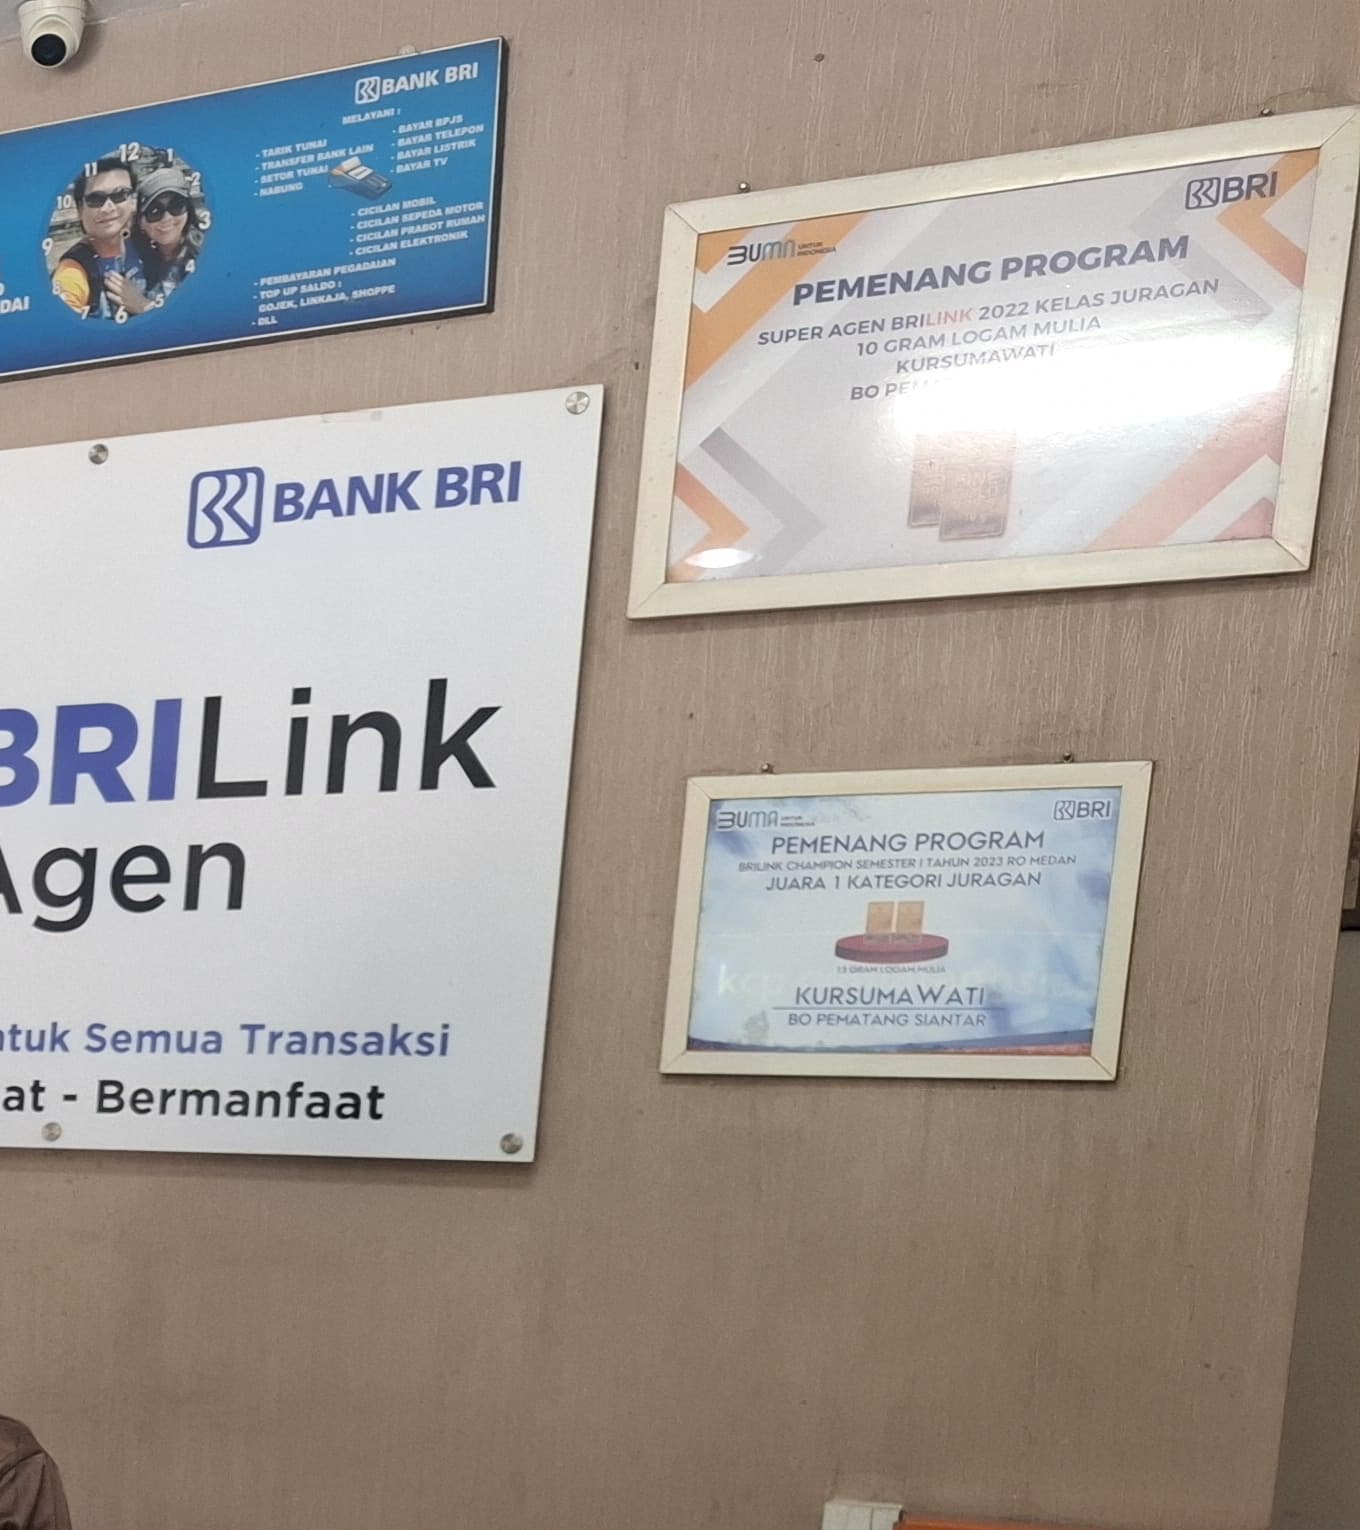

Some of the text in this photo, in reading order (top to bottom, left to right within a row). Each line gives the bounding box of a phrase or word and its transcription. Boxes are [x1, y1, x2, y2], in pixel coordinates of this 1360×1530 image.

[380, 62, 479, 96] BANK BRI
[397, 125, 484, 147] BAYAR TELEPON
[398, 121, 433, 134] BAYAR
[119, 142, 140, 162] 12
[295, 139, 327, 152] TUNAI
[397, 139, 476, 160] BAYAR LISTRIK
[167, 148, 173, 162] 1
[261, 143, 374, 171] TRANSFER BANK LAIN
[84, 162, 98, 177] 11
[297, 165, 328, 178] TUNAI
[396, 157, 448, 173] BAYAR TV
[191, 172, 201, 186] 2
[1221, 171, 1278, 203] BRI
[57, 194, 72, 209] 10
[357, 204, 400, 217] CICILAN
[199, 211, 211, 229] 3
[356, 217, 399, 230] CICILAN
[445, 202, 484, 215] MOTOR
[355, 231, 468, 255] CICILAN ELEKTRONIK
[356, 229, 398, 243] CICILAN
[42, 238, 53, 255] 9
[185, 259, 196, 273] 4
[333, 258, 396, 276] PEGADAIAN
[793, 234, 1189, 306] PEMENANG PROGRAM
[155, 294, 164, 307] 5
[81, 306, 90, 320] 7
[115, 306, 128, 324] 6
[758, 278, 1220, 346] SUPER AGEN BRILINK 2022 KELAS JURAGAN
[857, 316, 1101, 356] 10 GRAM LOGAM MULIA
[896, 343, 1055, 374] KURSUMAWATI
[850, 385, 879, 401] BO
[273, 460, 522, 523] BANK BRI
[1076, 800, 1111, 818] BRI
[771, 830, 1045, 855] PEMENANG PROGRAM
[786, 860, 853, 871] CHAMPION
[856, 858, 916, 870] SEMESTER
[927, 857, 970, 868] TAHUN
[973, 856, 1003, 867] 2023
[1030, 855, 1077, 866] MEDAN
[765, 872, 1042, 891] JUARA 1 KATEGORI JURAGAN
[794, 983, 985, 1005] KURSUMAWATI
[788, 1013, 987, 1027] BO PEMATANG SIANTAR
[84, 1022, 224, 1055] Semua
[239, 1022, 450, 1057] Transaksi
[95, 1078, 385, 1121] Bermanfaat
